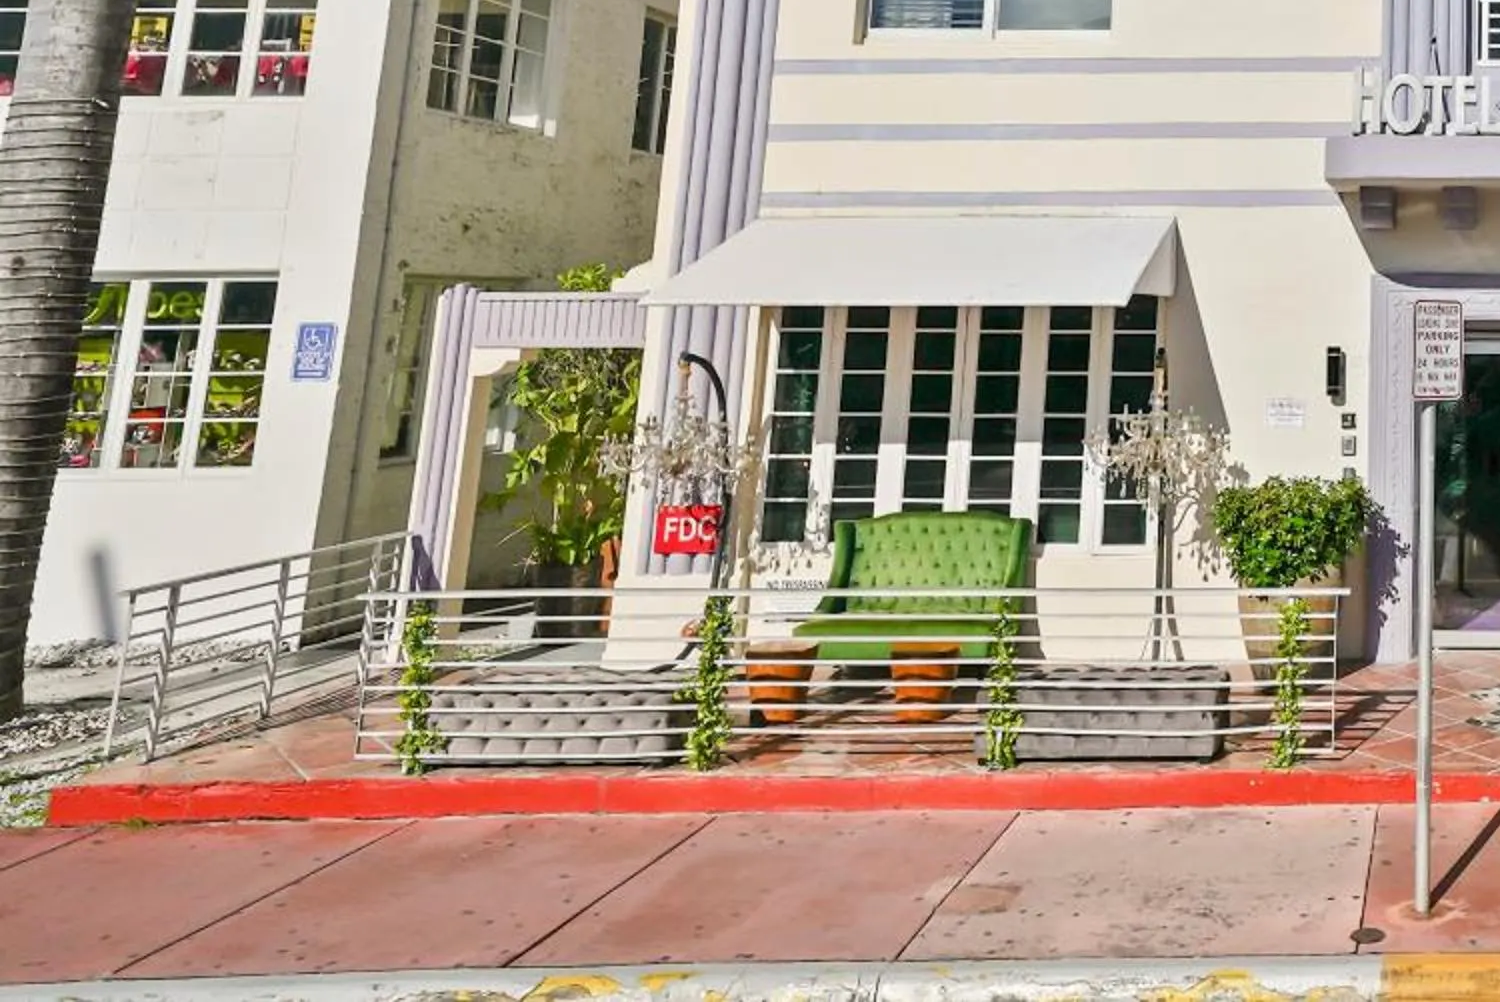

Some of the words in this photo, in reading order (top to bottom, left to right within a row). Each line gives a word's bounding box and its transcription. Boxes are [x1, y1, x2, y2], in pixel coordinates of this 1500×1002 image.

[1417, 331, 1459, 341] PARKING
[1425, 344, 1451, 355] ONLY
[663, 515, 717, 543] FDC
[767, 580, 779, 591] NO
[781, 580, 827, 591] TRESPASSIN
